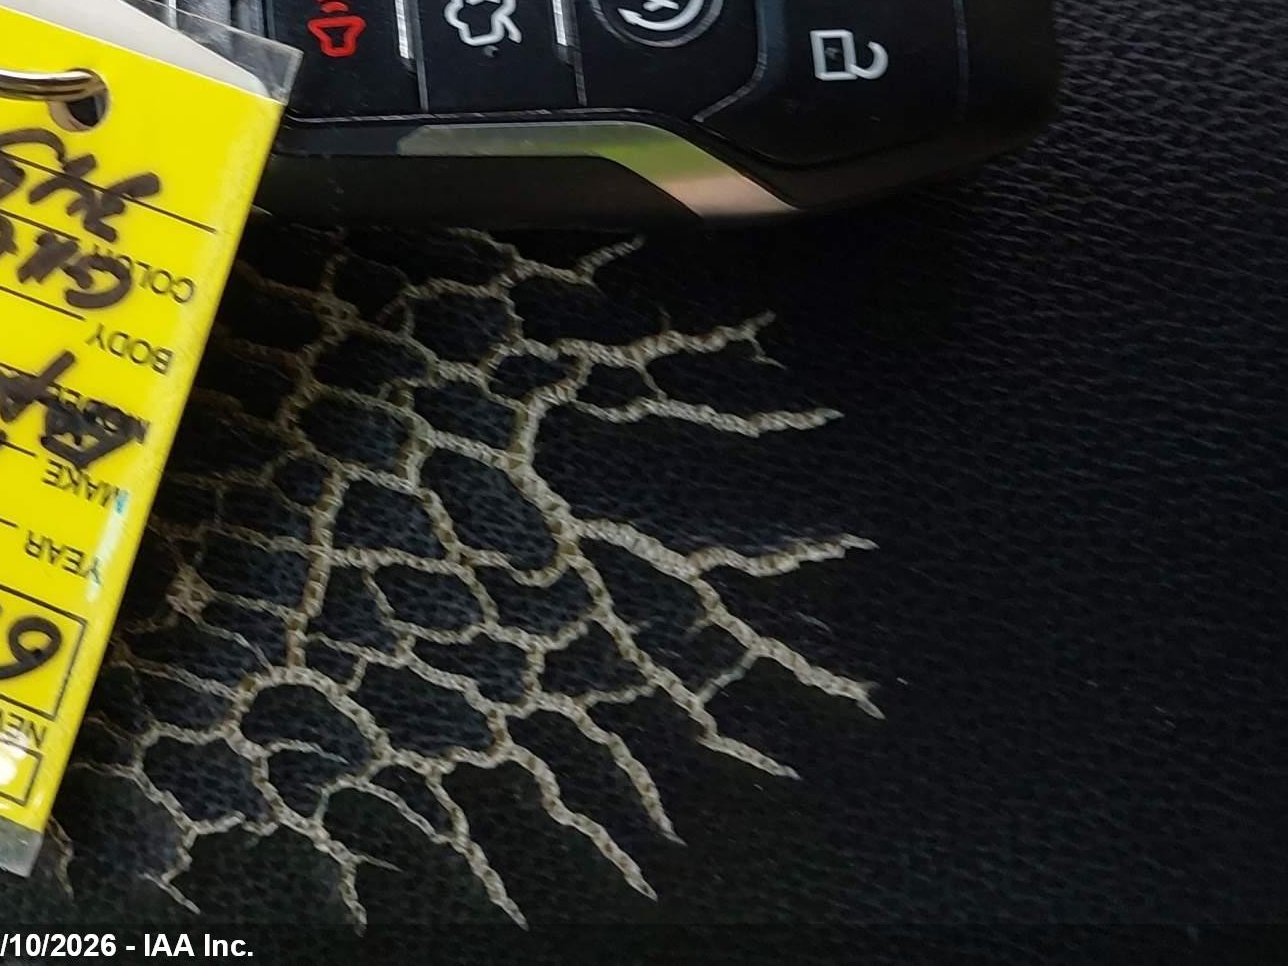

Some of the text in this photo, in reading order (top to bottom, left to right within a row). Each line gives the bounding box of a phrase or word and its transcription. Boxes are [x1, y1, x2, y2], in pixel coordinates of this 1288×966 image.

[85, 323, 174, 376] BODY
[43, 459, 131, 515] MAKE
[24, 530, 103, 587] YEAR
